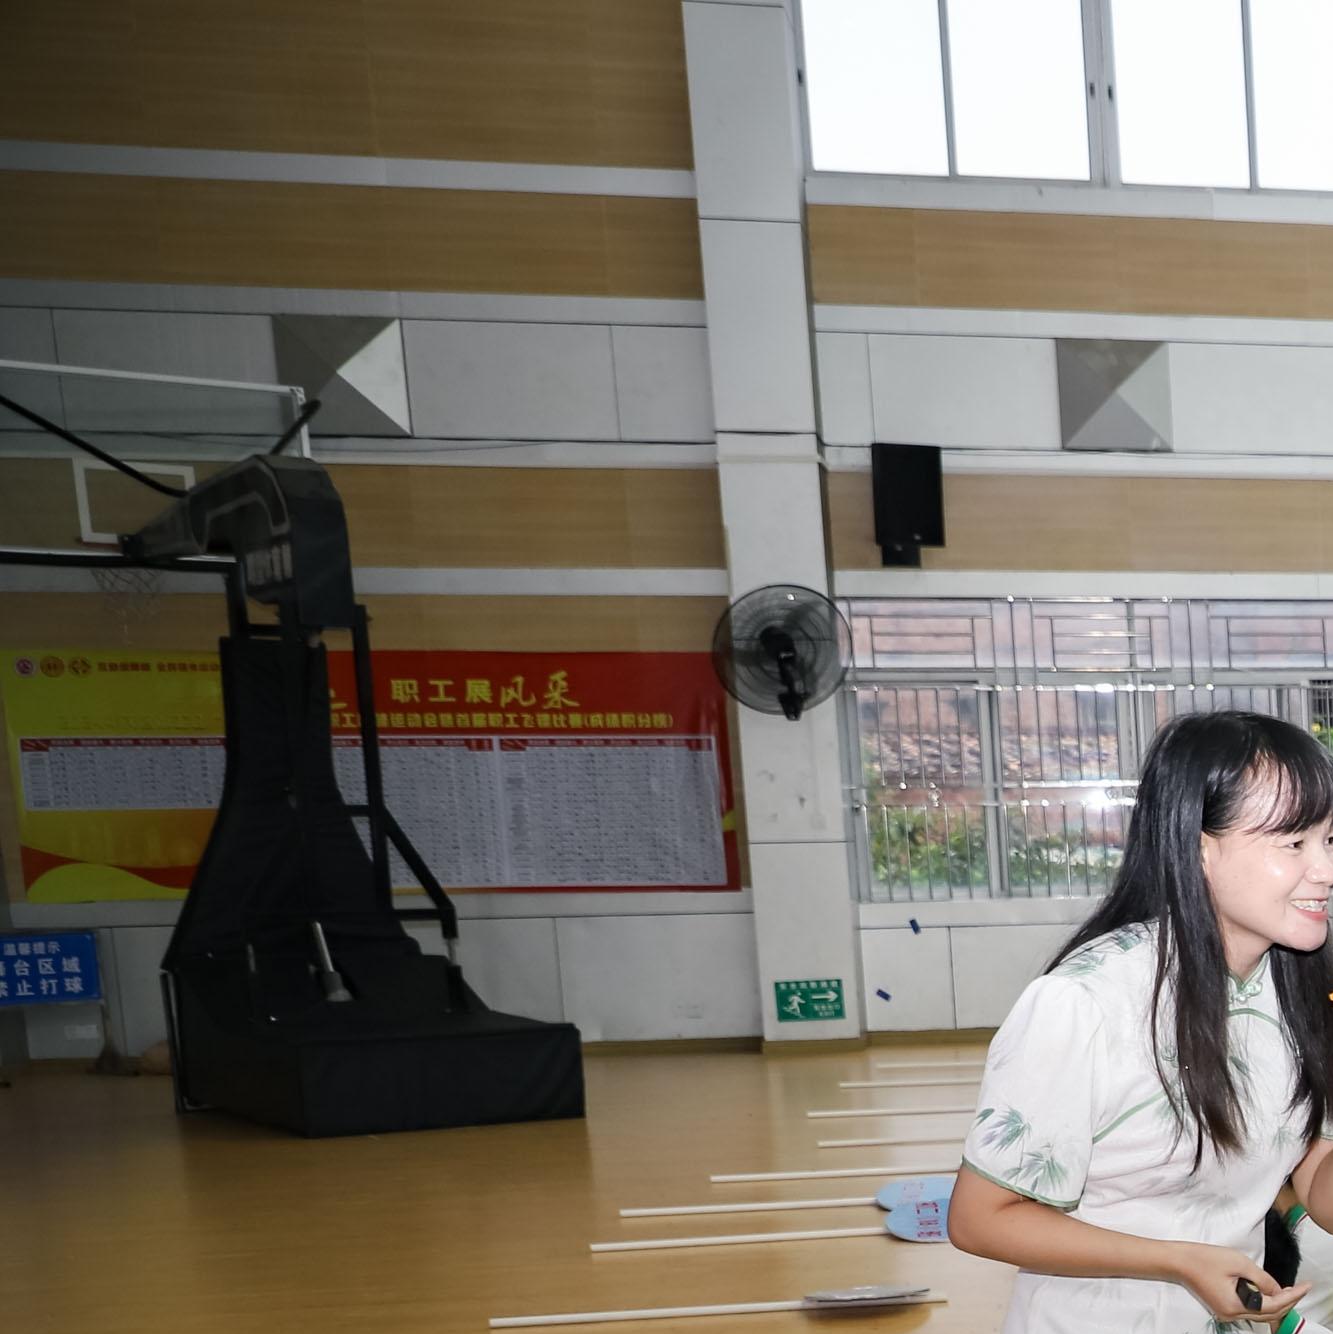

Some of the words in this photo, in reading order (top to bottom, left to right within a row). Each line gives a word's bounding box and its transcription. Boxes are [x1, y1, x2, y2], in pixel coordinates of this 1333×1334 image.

[389, 669, 581, 711] 职工展风采
